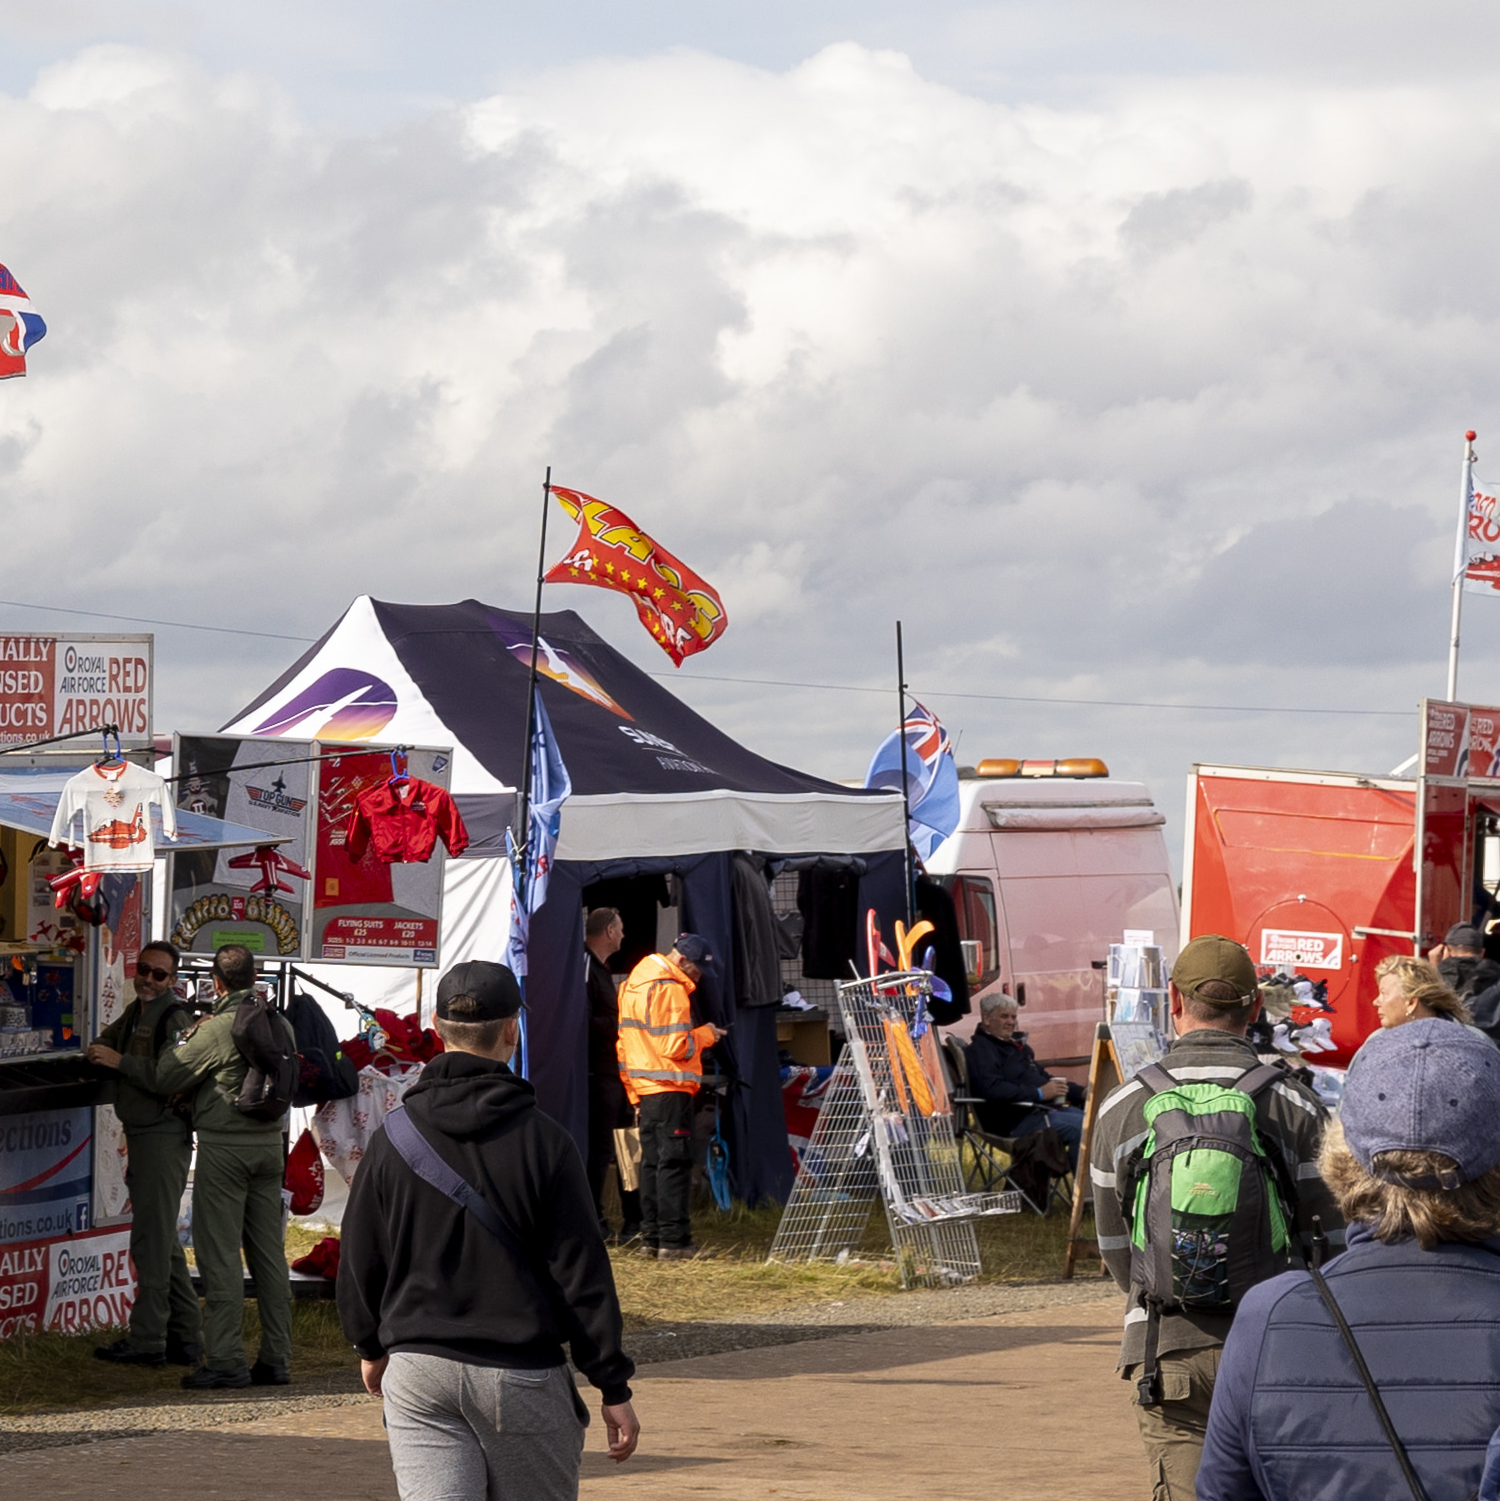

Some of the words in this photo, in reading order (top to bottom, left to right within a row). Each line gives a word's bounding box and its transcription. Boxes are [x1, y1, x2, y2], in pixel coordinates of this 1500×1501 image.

[78, 657, 106, 673] ROYAL
[108, 657, 147, 693] RED
[59, 677, 76, 694] AIR
[77, 677, 106, 693] FORCE
[58, 698, 147, 734] ARROWS
[338, 920, 362, 928] FLYING
[364, 920, 384, 929] SUITS
[394, 922, 423, 930] JACKETS
[1298, 938, 1324, 952] RED
[1266, 950, 1324, 964] ARROWS
[69, 1255, 101, 1276] ROYAL
[67, 1274, 101, 1295] FORCE
